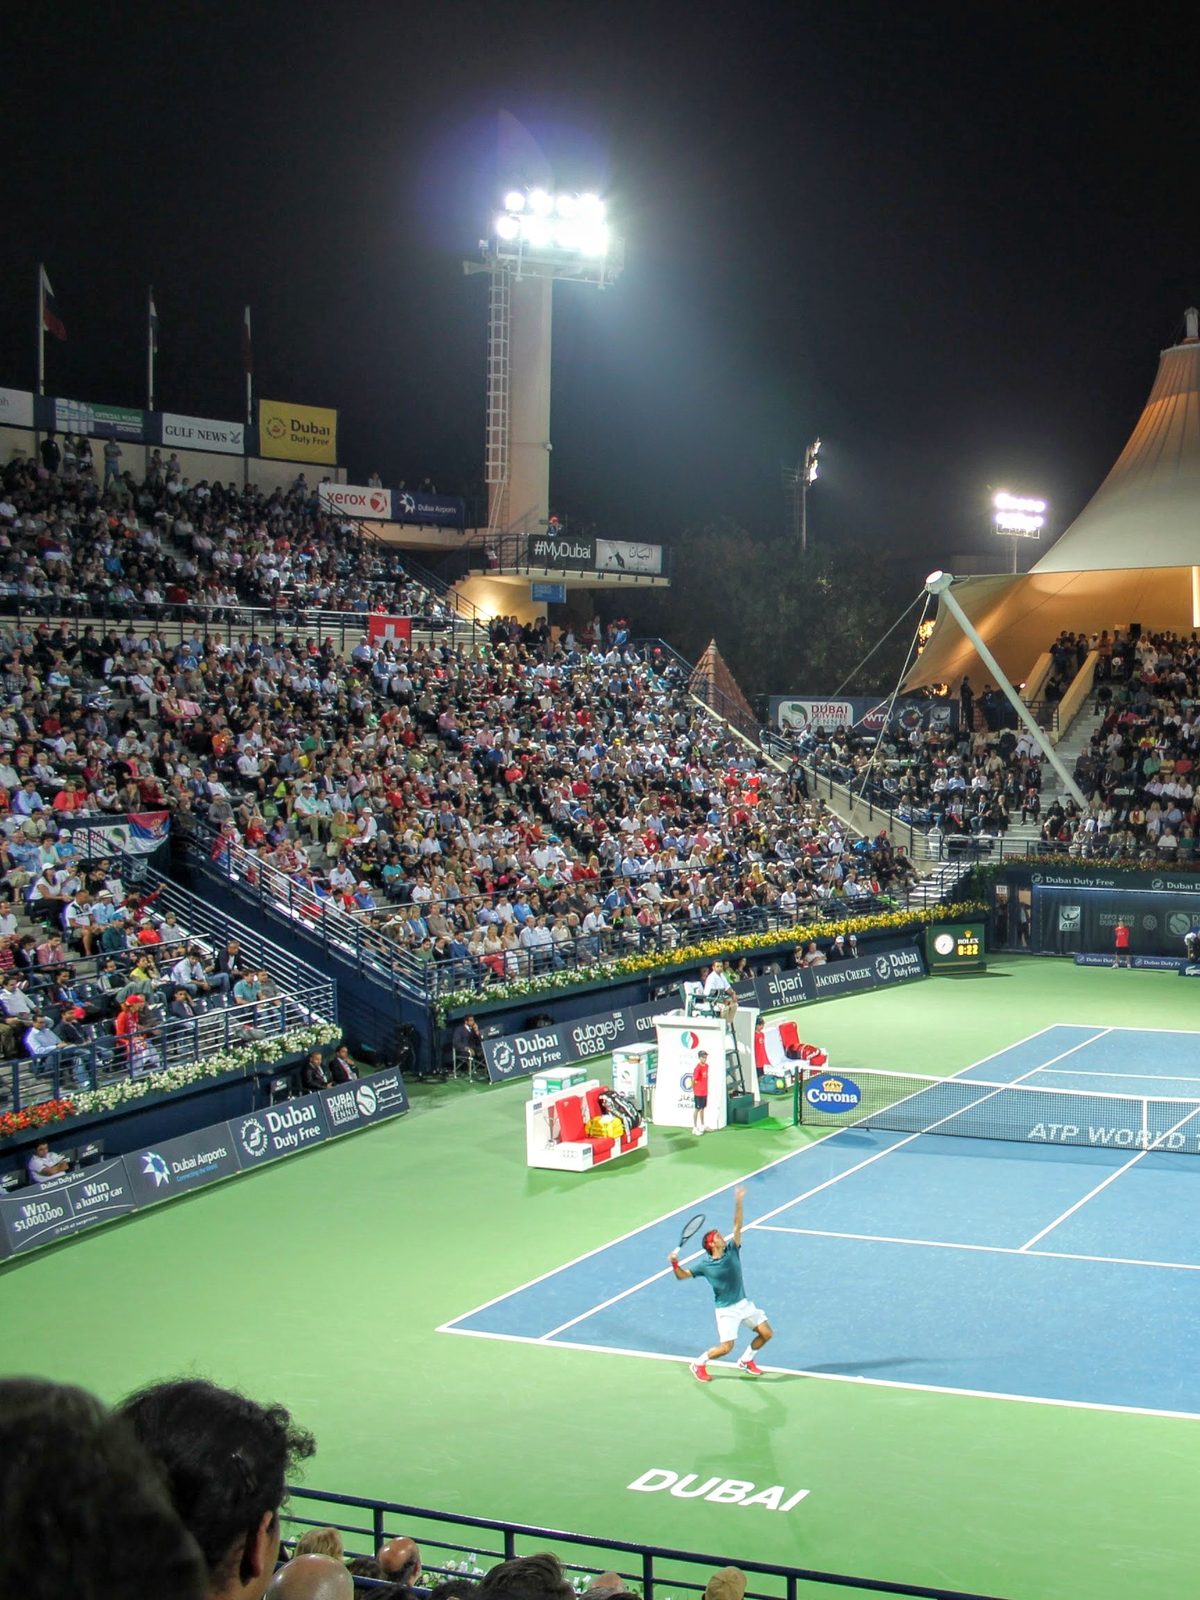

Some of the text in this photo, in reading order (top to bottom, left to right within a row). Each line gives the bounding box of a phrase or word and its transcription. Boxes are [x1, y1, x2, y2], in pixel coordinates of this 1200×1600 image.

[165, 425, 228, 443] GULF NEWS
[290, 419, 330, 436] Dubai
[290, 433, 330, 446] Duty Free
[327, 492, 366, 506] xerox
[534, 540, 592, 560] #MyDubai
[811, 704, 849, 715] DUBAI
[1046, 876, 1114, 886] Dubai Duty Free
[1166, 881, 1193, 889] Dubai
[1061, 921, 1079, 929] ATP
[957, 937, 979, 945] ROLEX
[889, 951, 919, 967] Dubai
[815, 967, 872, 988] JACOB'S CREEK
[893, 965, 921, 978] Duty Free
[768, 972, 803, 998] alpari
[772, 992, 807, 1007] FX TRADING
[515, 1032, 559, 1055] Dubai
[575, 1037, 605, 1057] 103.8
[520, 1050, 562, 1069] Duty Free
[326, 1090, 355, 1108] DUBAI
[806, 1088, 858, 1103] Corona
[266, 1104, 317, 1133] Dubai
[332, 1106, 358, 1121] TENNIS
[273, 1124, 321, 1150] Duty Free
[1027, 1122, 1080, 1141] ATP
[1088, 1126, 1186, 1149] WORLD
[172, 1147, 227, 1173] Dubai Airports
[40, 1171, 85, 1190] Dubai Duty Free
[84, 1182, 110, 1196] Win
[76, 1186, 124, 1209] a luxury car
[22, 1201, 51, 1217] Win
[14, 1206, 64, 1232] $1,000,000
[626, 1468, 811, 1512] DUBAI
